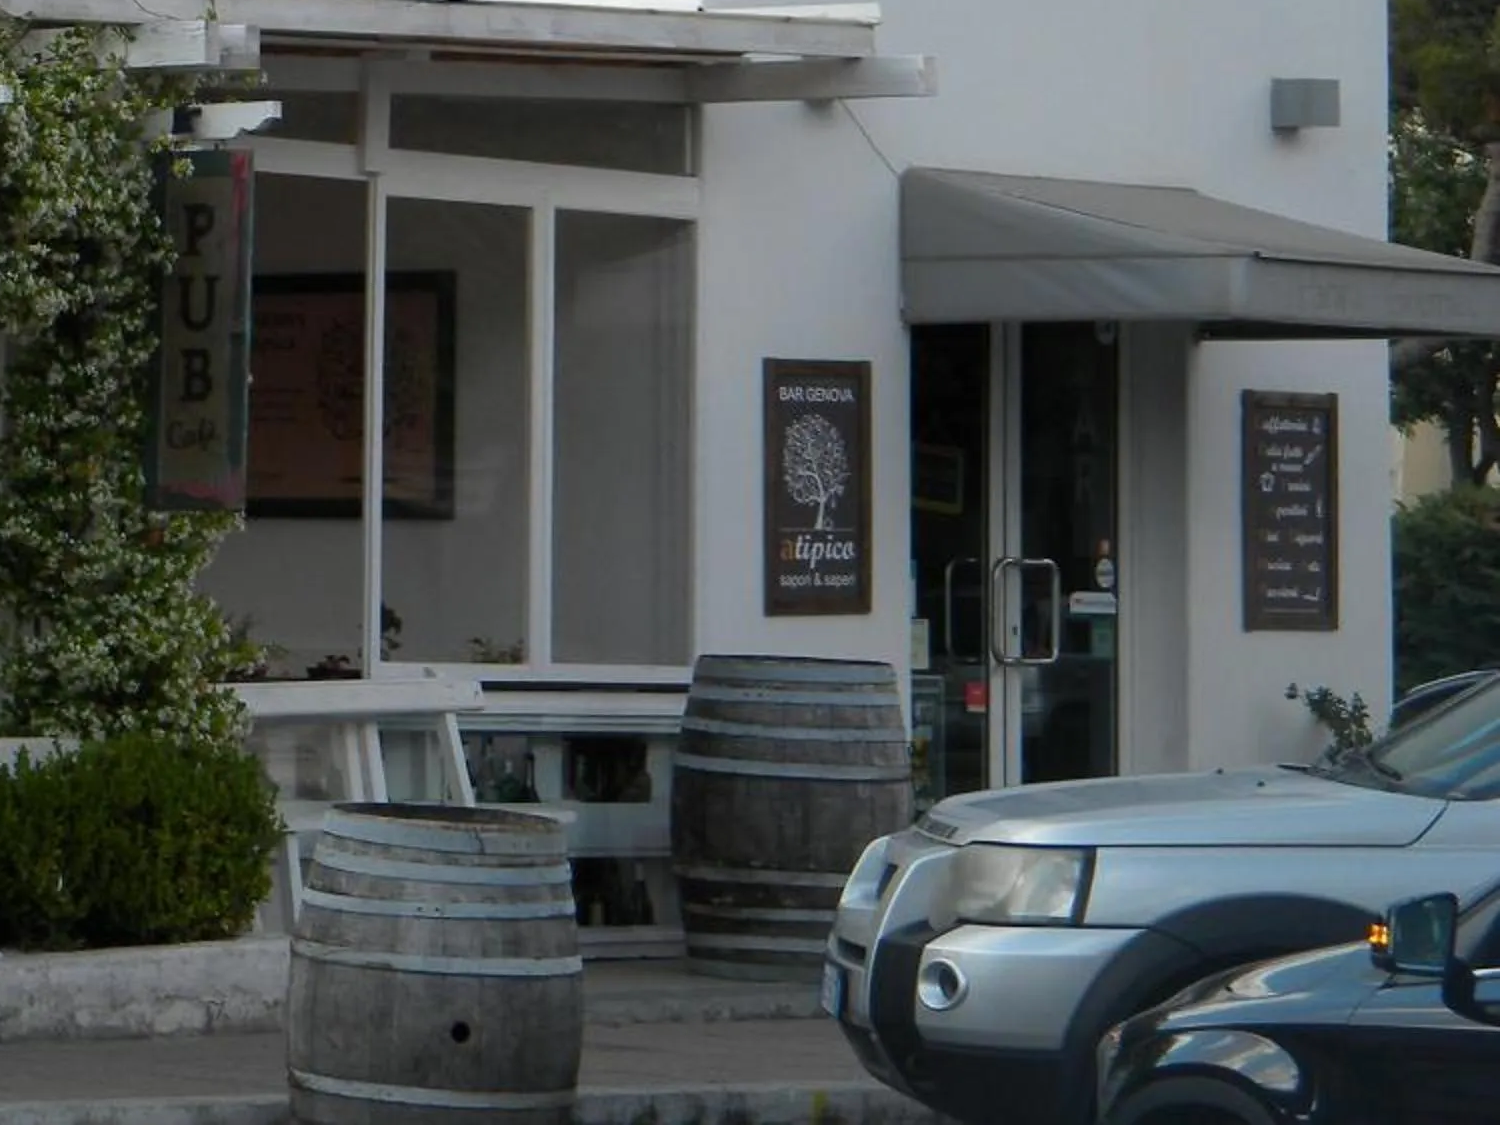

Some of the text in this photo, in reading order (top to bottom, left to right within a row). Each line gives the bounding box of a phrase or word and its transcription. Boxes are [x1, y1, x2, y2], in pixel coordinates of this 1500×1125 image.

[179, 203, 221, 402] PUB
[778, 386, 856, 403] BAR GENOVA
[779, 534, 855, 569] atipico
